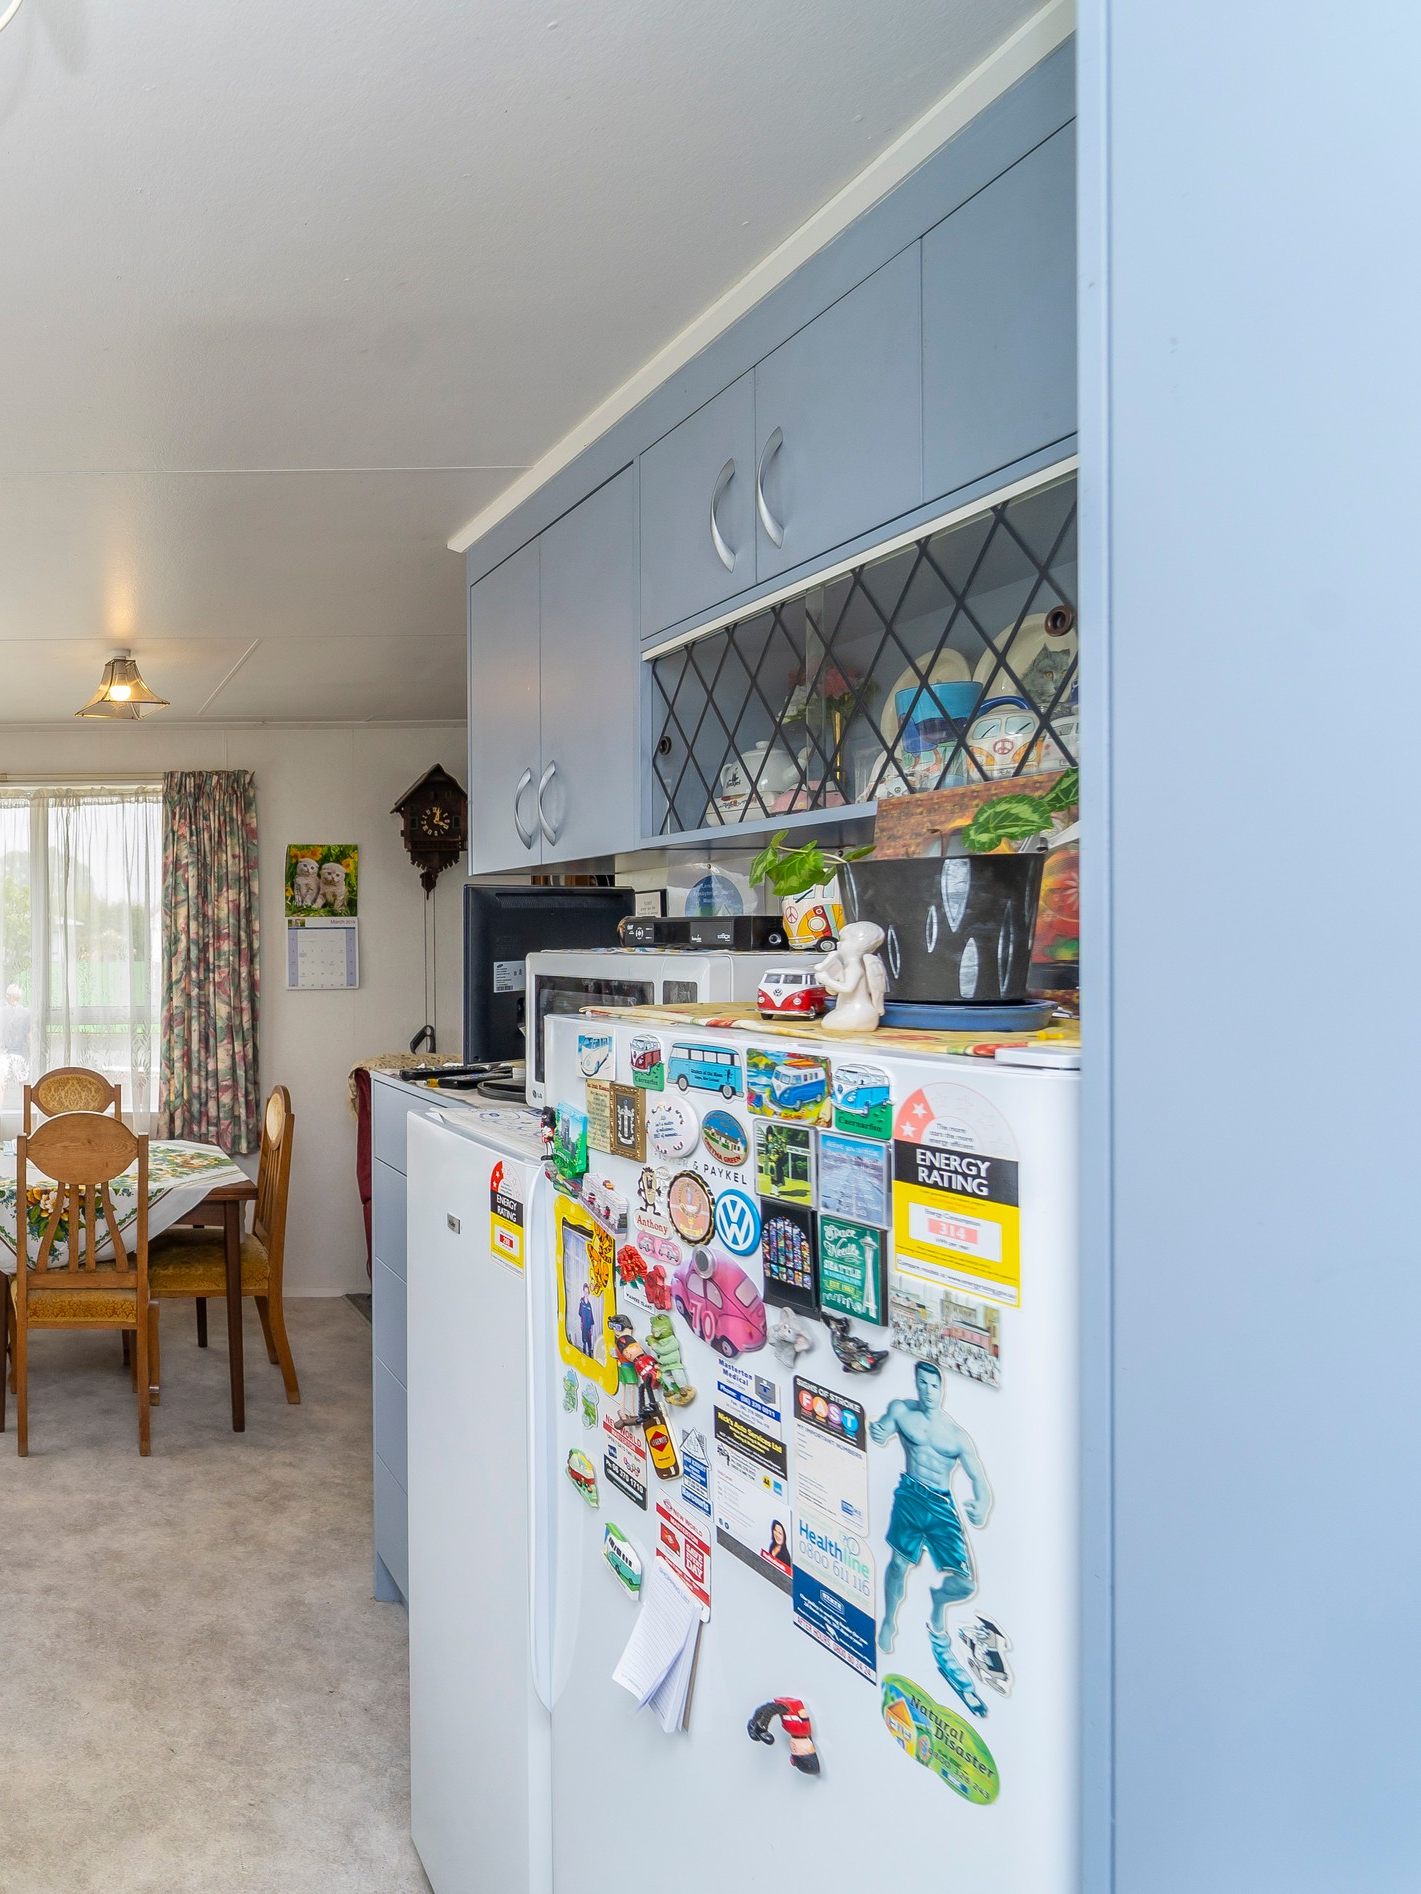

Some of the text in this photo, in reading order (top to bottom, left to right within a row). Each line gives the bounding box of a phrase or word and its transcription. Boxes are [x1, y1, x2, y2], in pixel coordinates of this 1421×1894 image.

[838, 1116, 883, 1133] Caernarfon
[723, 1155, 741, 1164] GREEN
[915, 1148, 991, 1178] ENERGY
[703, 1163, 748, 1186] PAYKEL
[917, 1166, 989, 1196] RATING
[496, 1194, 517, 1211] ENERGY
[497, 1205, 517, 1222] RATING
[636, 1214, 669, 1235] Anthony
[823, 1225, 858, 1240] Space
[940, 1223, 966, 1240] 314
[823, 1238, 863, 1259] Needle
[823, 1259, 862, 1280] SEATTLE
[690, 1300, 716, 1343] 70
[718, 1358, 752, 1381] Masterton
[722, 1367, 748, 1386] Medical
[719, 1383, 736, 1398] Phone:
[796, 1377, 860, 1414] SIGNS OF STROKE
[801, 1390, 855, 1430] FAST
[734, 1421, 746, 1434] Auto
[747, 1428, 771, 1448] Services
[771, 1441, 782, 1454] Ltd
[686, 1543, 703, 1562] SAVE
[799, 1518, 869, 1580] Healthline
[686, 1559, 703, 1580] DAY
[799, 1536, 828, 1570] 0800
[832, 1558, 848, 1584] 611
[851, 1570, 869, 1598] 116
[911, 1694, 965, 1745] Natural
[933, 1725, 995, 1779] Disaster
